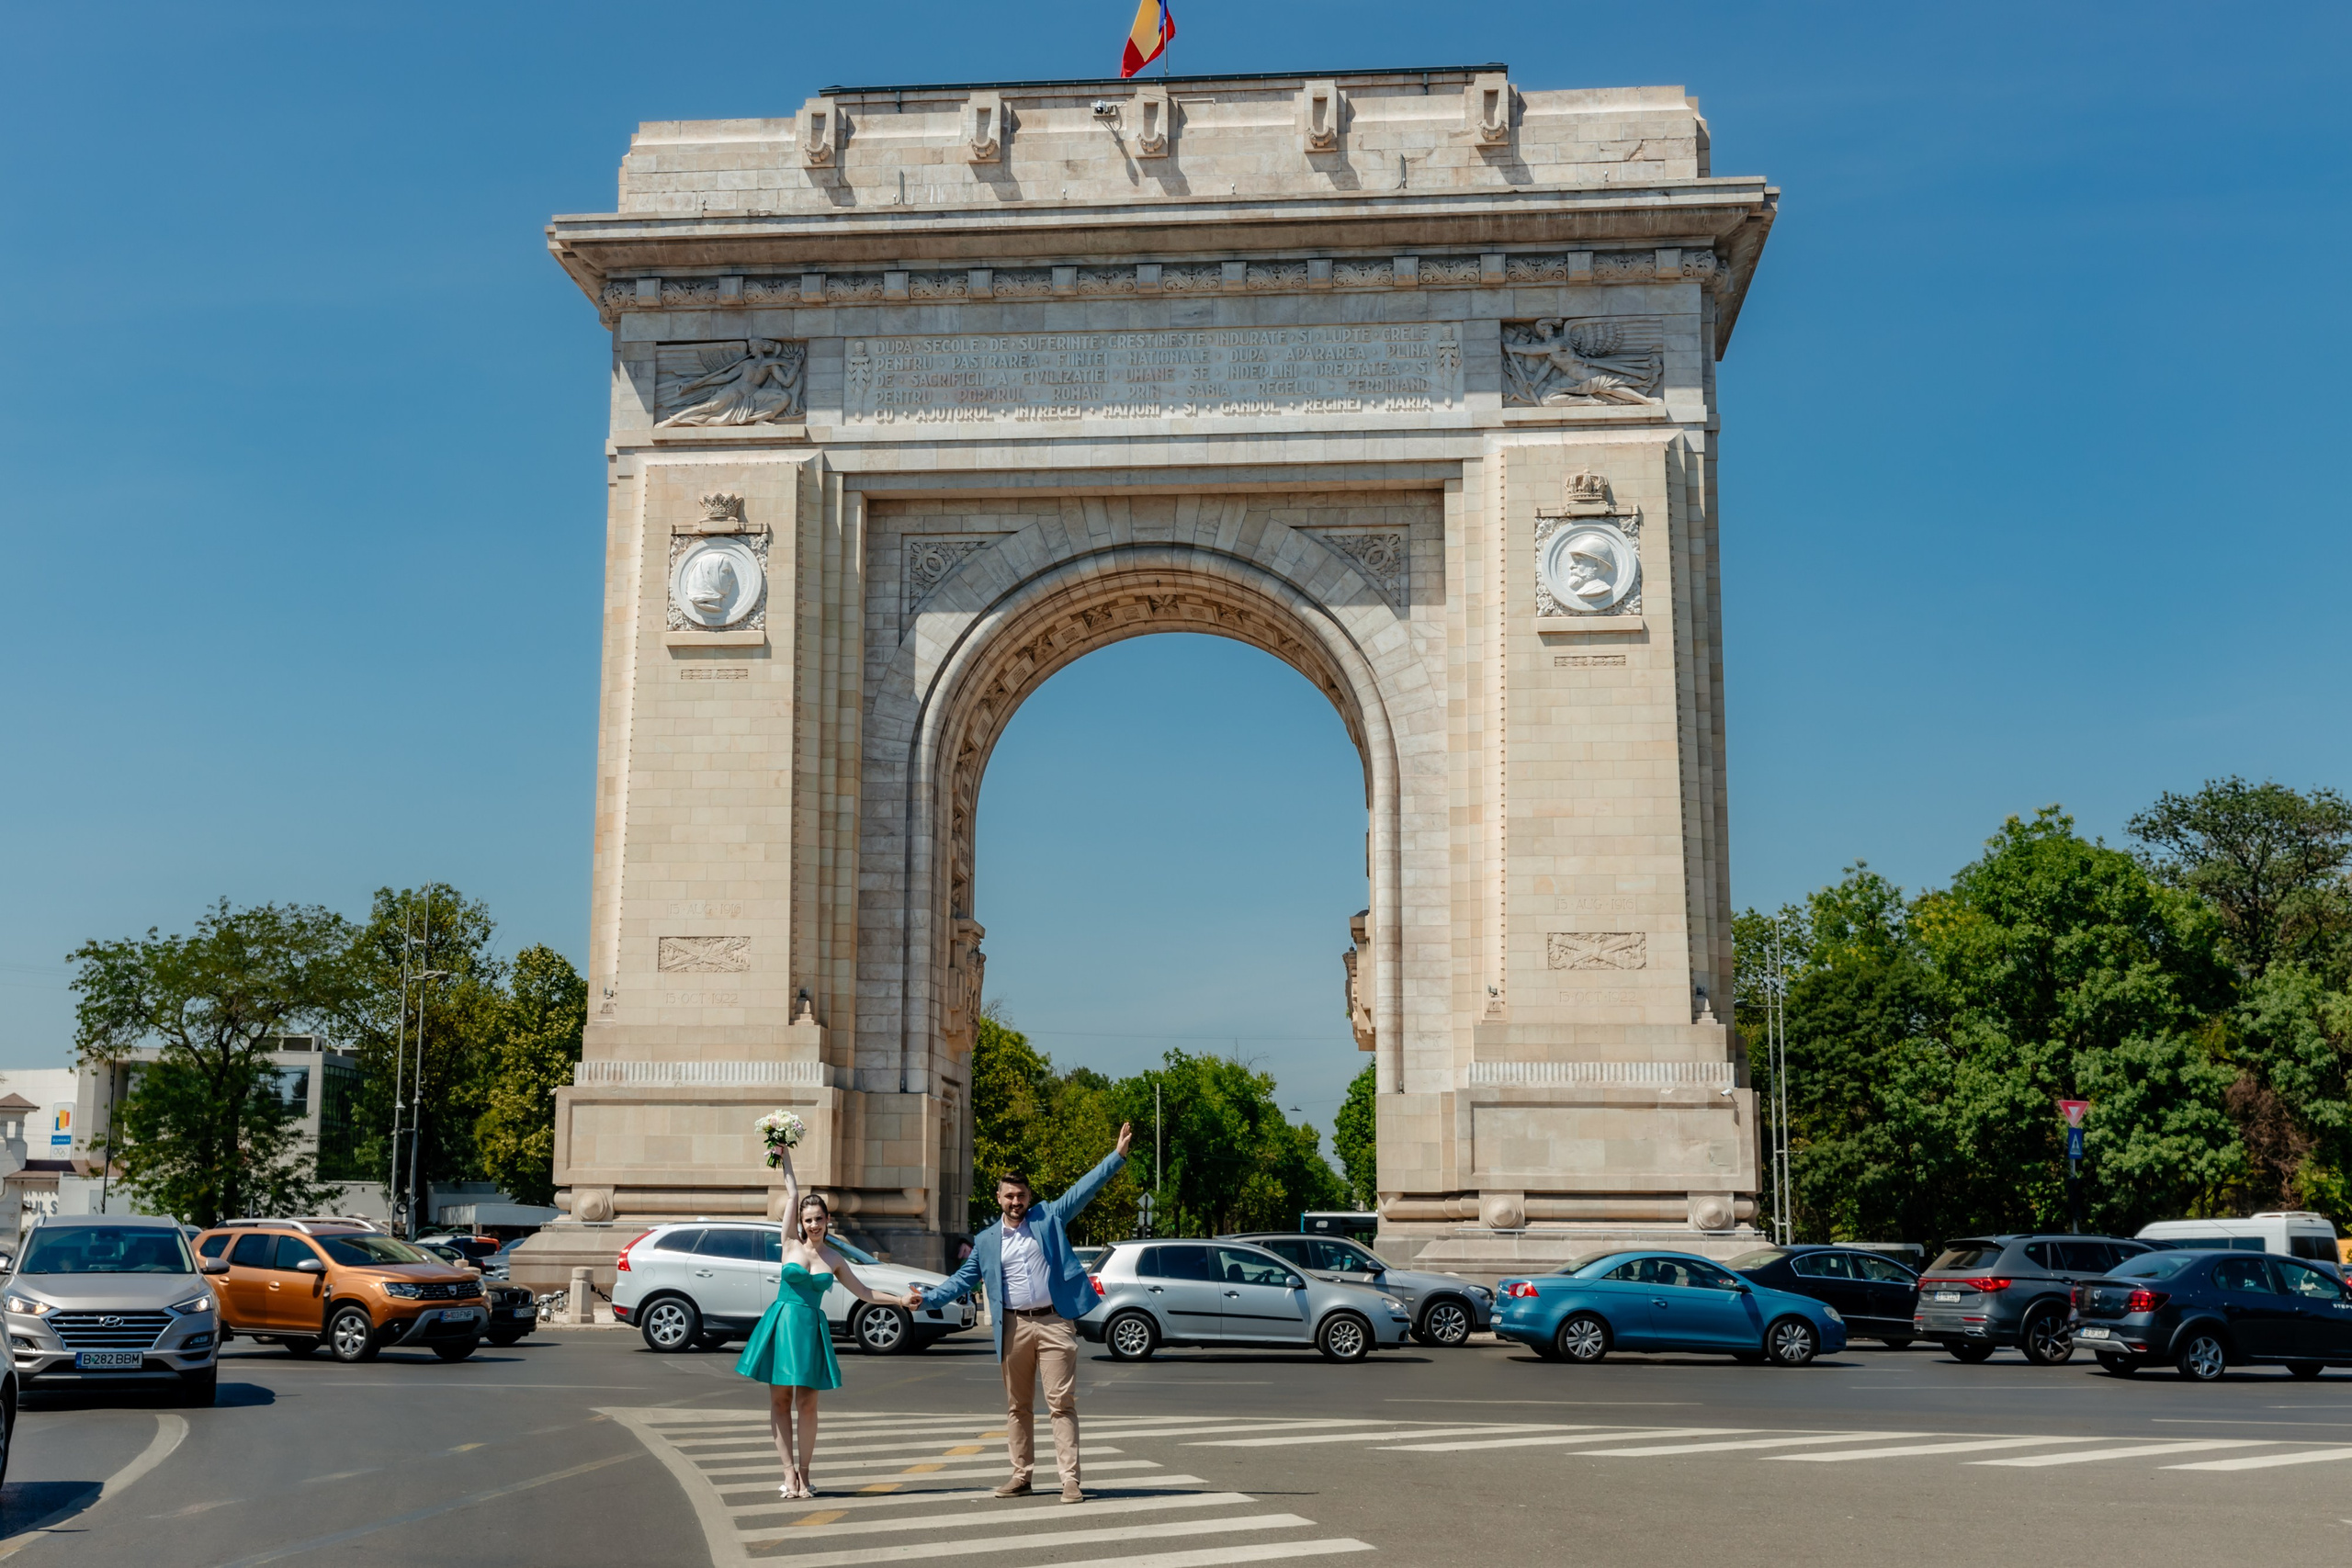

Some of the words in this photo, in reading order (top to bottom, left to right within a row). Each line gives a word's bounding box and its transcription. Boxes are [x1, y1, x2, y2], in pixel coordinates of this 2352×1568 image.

[875, 340, 914, 355] DUPA
[923, 339, 980, 354] SECOLE
[989, 337, 1010, 352] DE
[1019, 335, 1101, 352] SUFERINTE
[1108, 333, 1206, 349] CRESTINESTE
[1216, 331, 1288, 346] INDURATE
[1298, 330, 1313, 344] SI
[1324, 328, 1371, 344] LUPTE
[1381, 326, 1430, 342] GRELE
[875, 356, 933, 372] PENTRU
[952, 355, 1040, 370] PASTRAREA
[1057, 352, 1109, 367] FIINTEI
[1128, 349, 1212, 366] NATIONALE
[1228, 348, 1268, 363] DUPA
[1284, 346, 1367, 362] APARAREA
[1386, 344, 1432, 359] PLINA
[875, 374, 895, 388] DE
[910, 372, 985, 387] SACRIFICII
[997, 370, 1009, 385] A
[1022, 368, 1109, 385] CIVILIZATIEI
[1126, 367, 1176, 383] UMANE
[1191, 366, 1210, 381] SE
[1227, 364, 1298, 379] INDEPLINI
[1315, 362, 1400, 378] DREPTATEA
[1417, 360, 1433, 375] SI
[875, 389, 933, 405] PENTRU
[957, 388, 1026, 403] POPORUL
[1052, 386, 1102, 401] ROMAN
[1128, 384, 1161, 399] PRIN
[1186, 382, 1231, 398] SABIA
[1259, 380, 1318, 396] REGELUI
[1345, 378, 1431, 394] FERDINAND
[875, 407, 896, 423] CU
[916, 405, 994, 423] AJUTORUL
[1014, 403, 1082, 422] INTREGEI
[1102, 401, 1161, 419] NATIUNI
[1182, 400, 1198, 417] SI
[1220, 399, 1281, 416] GANDUL
[1303, 397, 1363, 413] REGINEI
[1385, 395, 1434, 412] MARIA
[83, 1354, 91, 1365] B
[94, 1354, 113, 1365] 282
[116, 1353, 140, 1365] BBM
